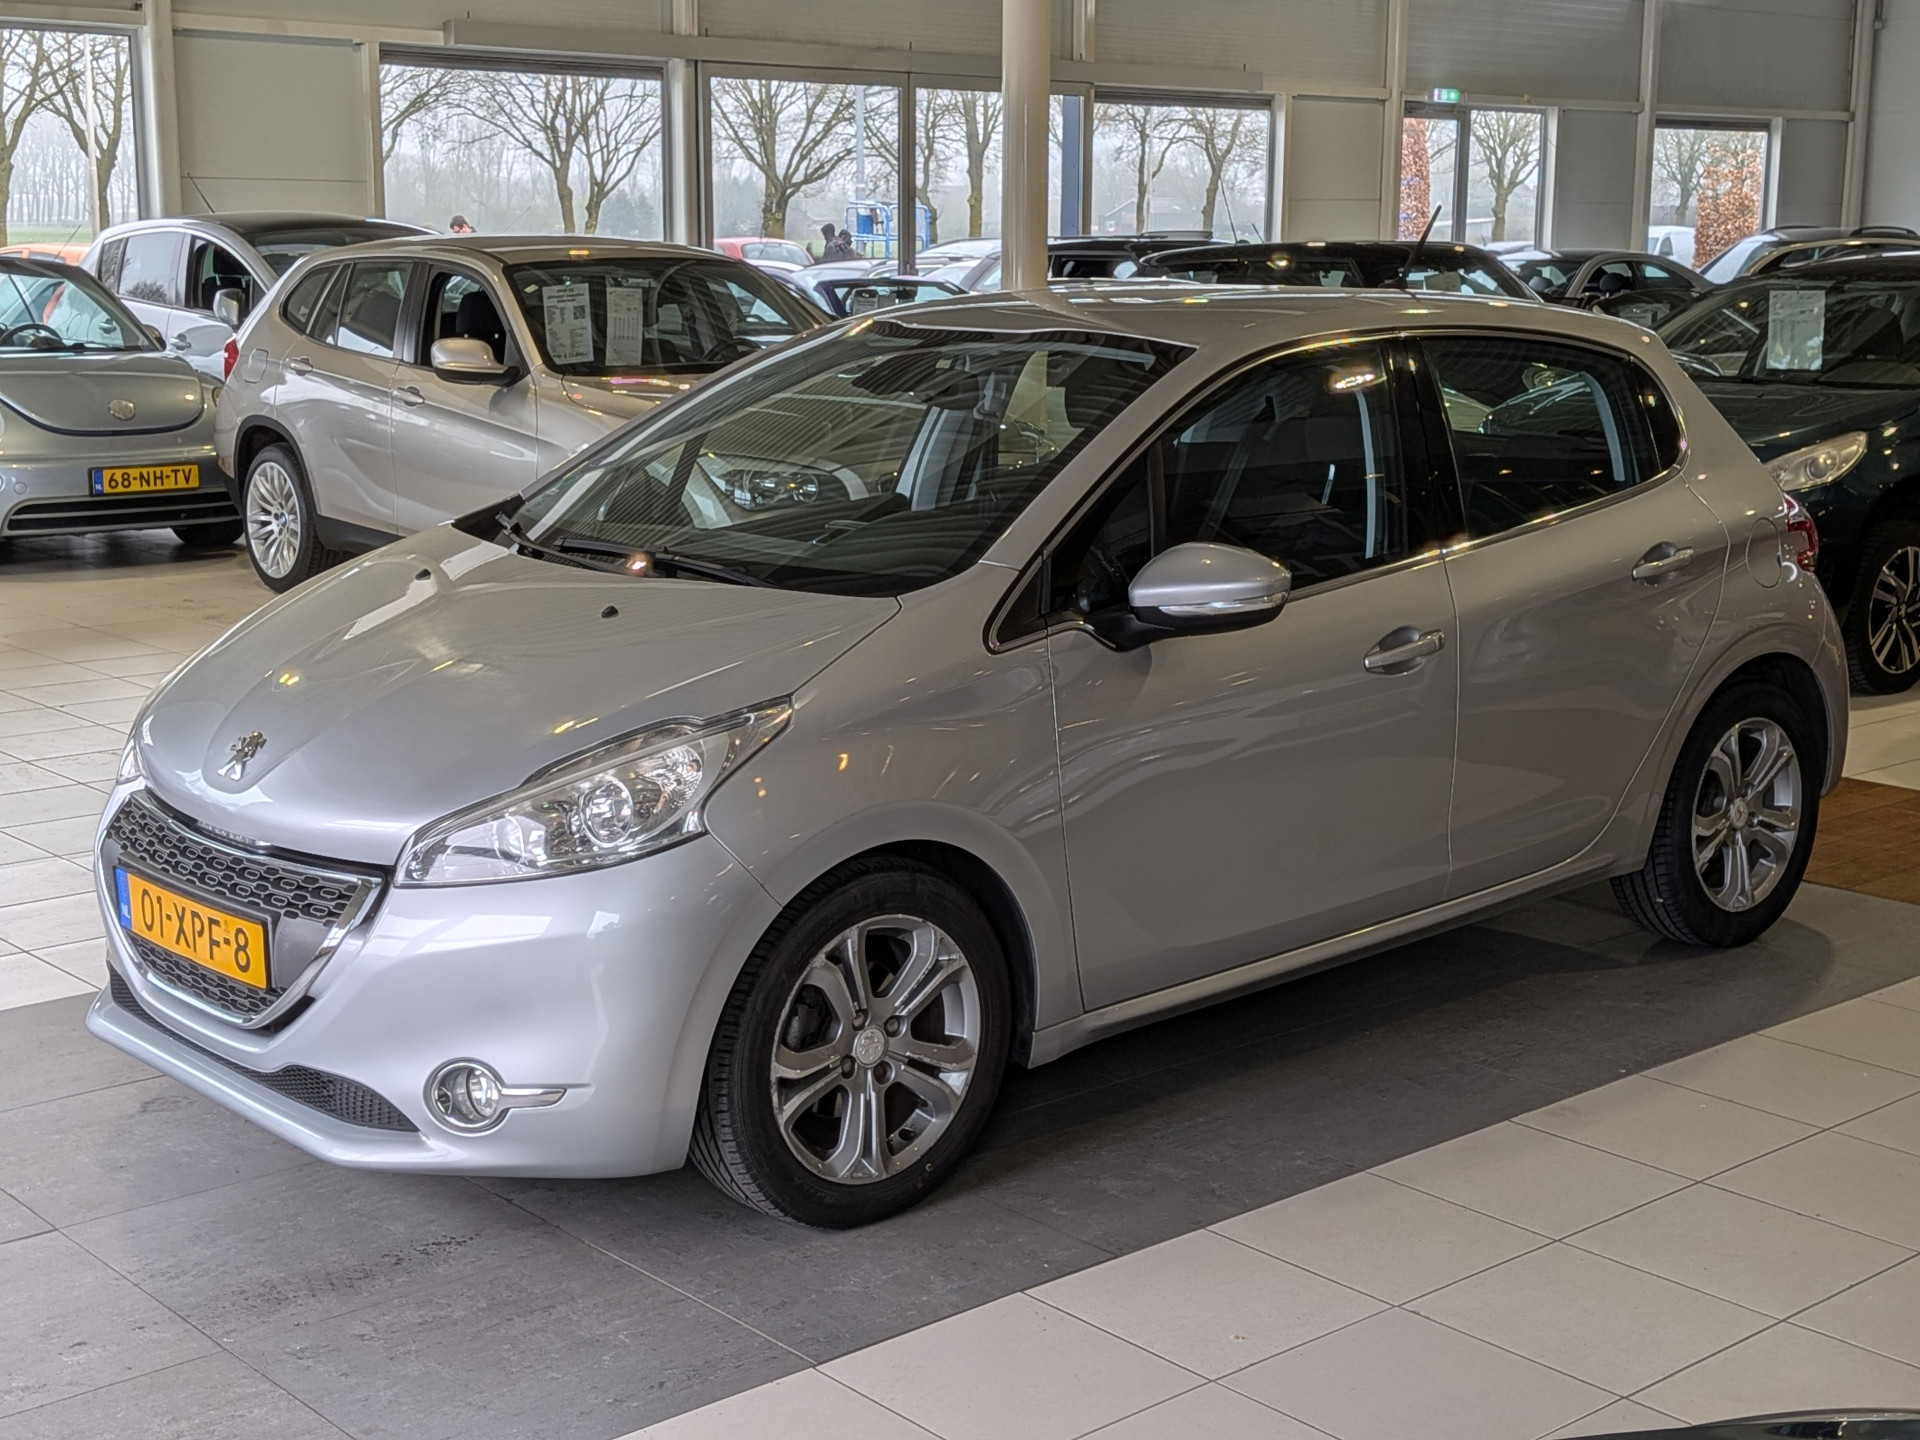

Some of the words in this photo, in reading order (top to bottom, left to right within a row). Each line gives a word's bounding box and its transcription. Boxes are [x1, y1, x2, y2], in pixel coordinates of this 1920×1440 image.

[108, 468, 192, 490] 68-NH-TV
[121, 901, 131, 919] NL
[140, 887, 252, 974] 01-XPF-8
